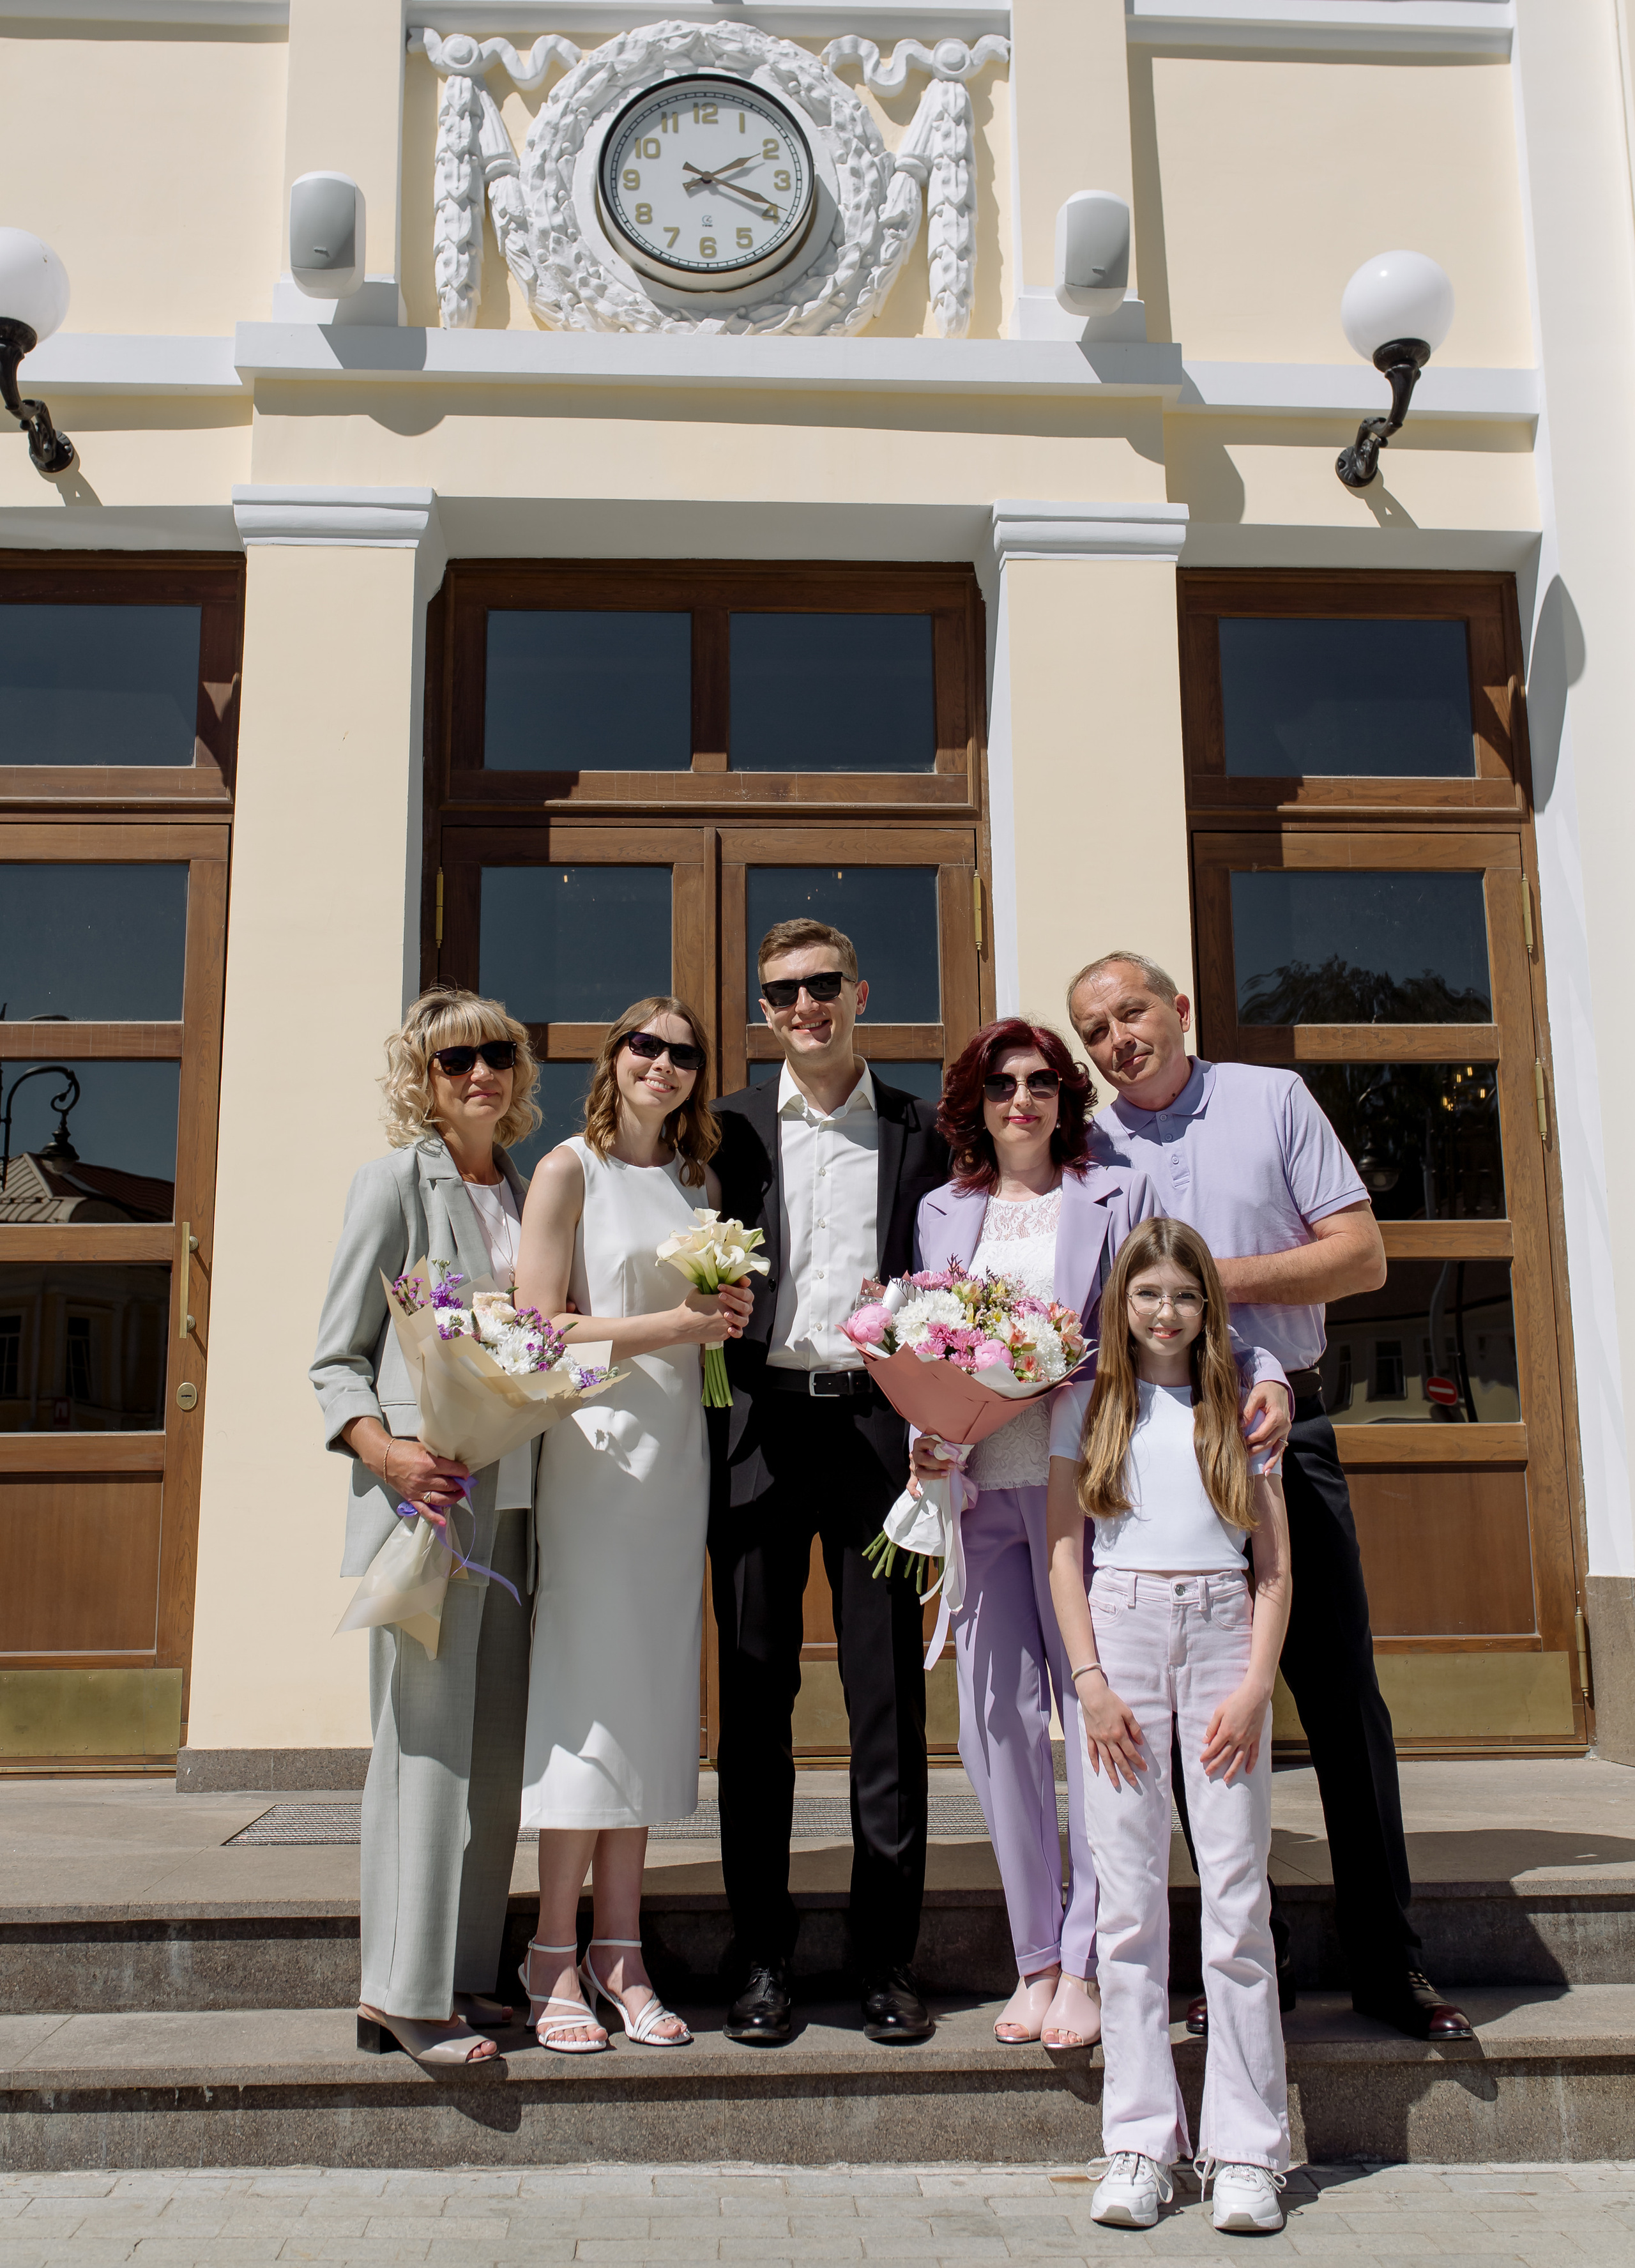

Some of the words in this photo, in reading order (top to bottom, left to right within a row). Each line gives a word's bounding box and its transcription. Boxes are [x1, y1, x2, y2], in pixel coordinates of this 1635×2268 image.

[661, 111, 678, 133] 11
[693, 102, 719, 124] 12
[738, 112, 745, 133] 1
[634, 137, 660, 158] 10
[762, 138, 779, 159] 2
[622, 169, 640, 190] 9
[773, 170, 791, 190] 3
[634, 202, 653, 224] 8
[761, 203, 779, 225] 4
[663, 227, 680, 248] 7
[699, 236, 717, 257] 6
[735, 227, 753, 248] 5
